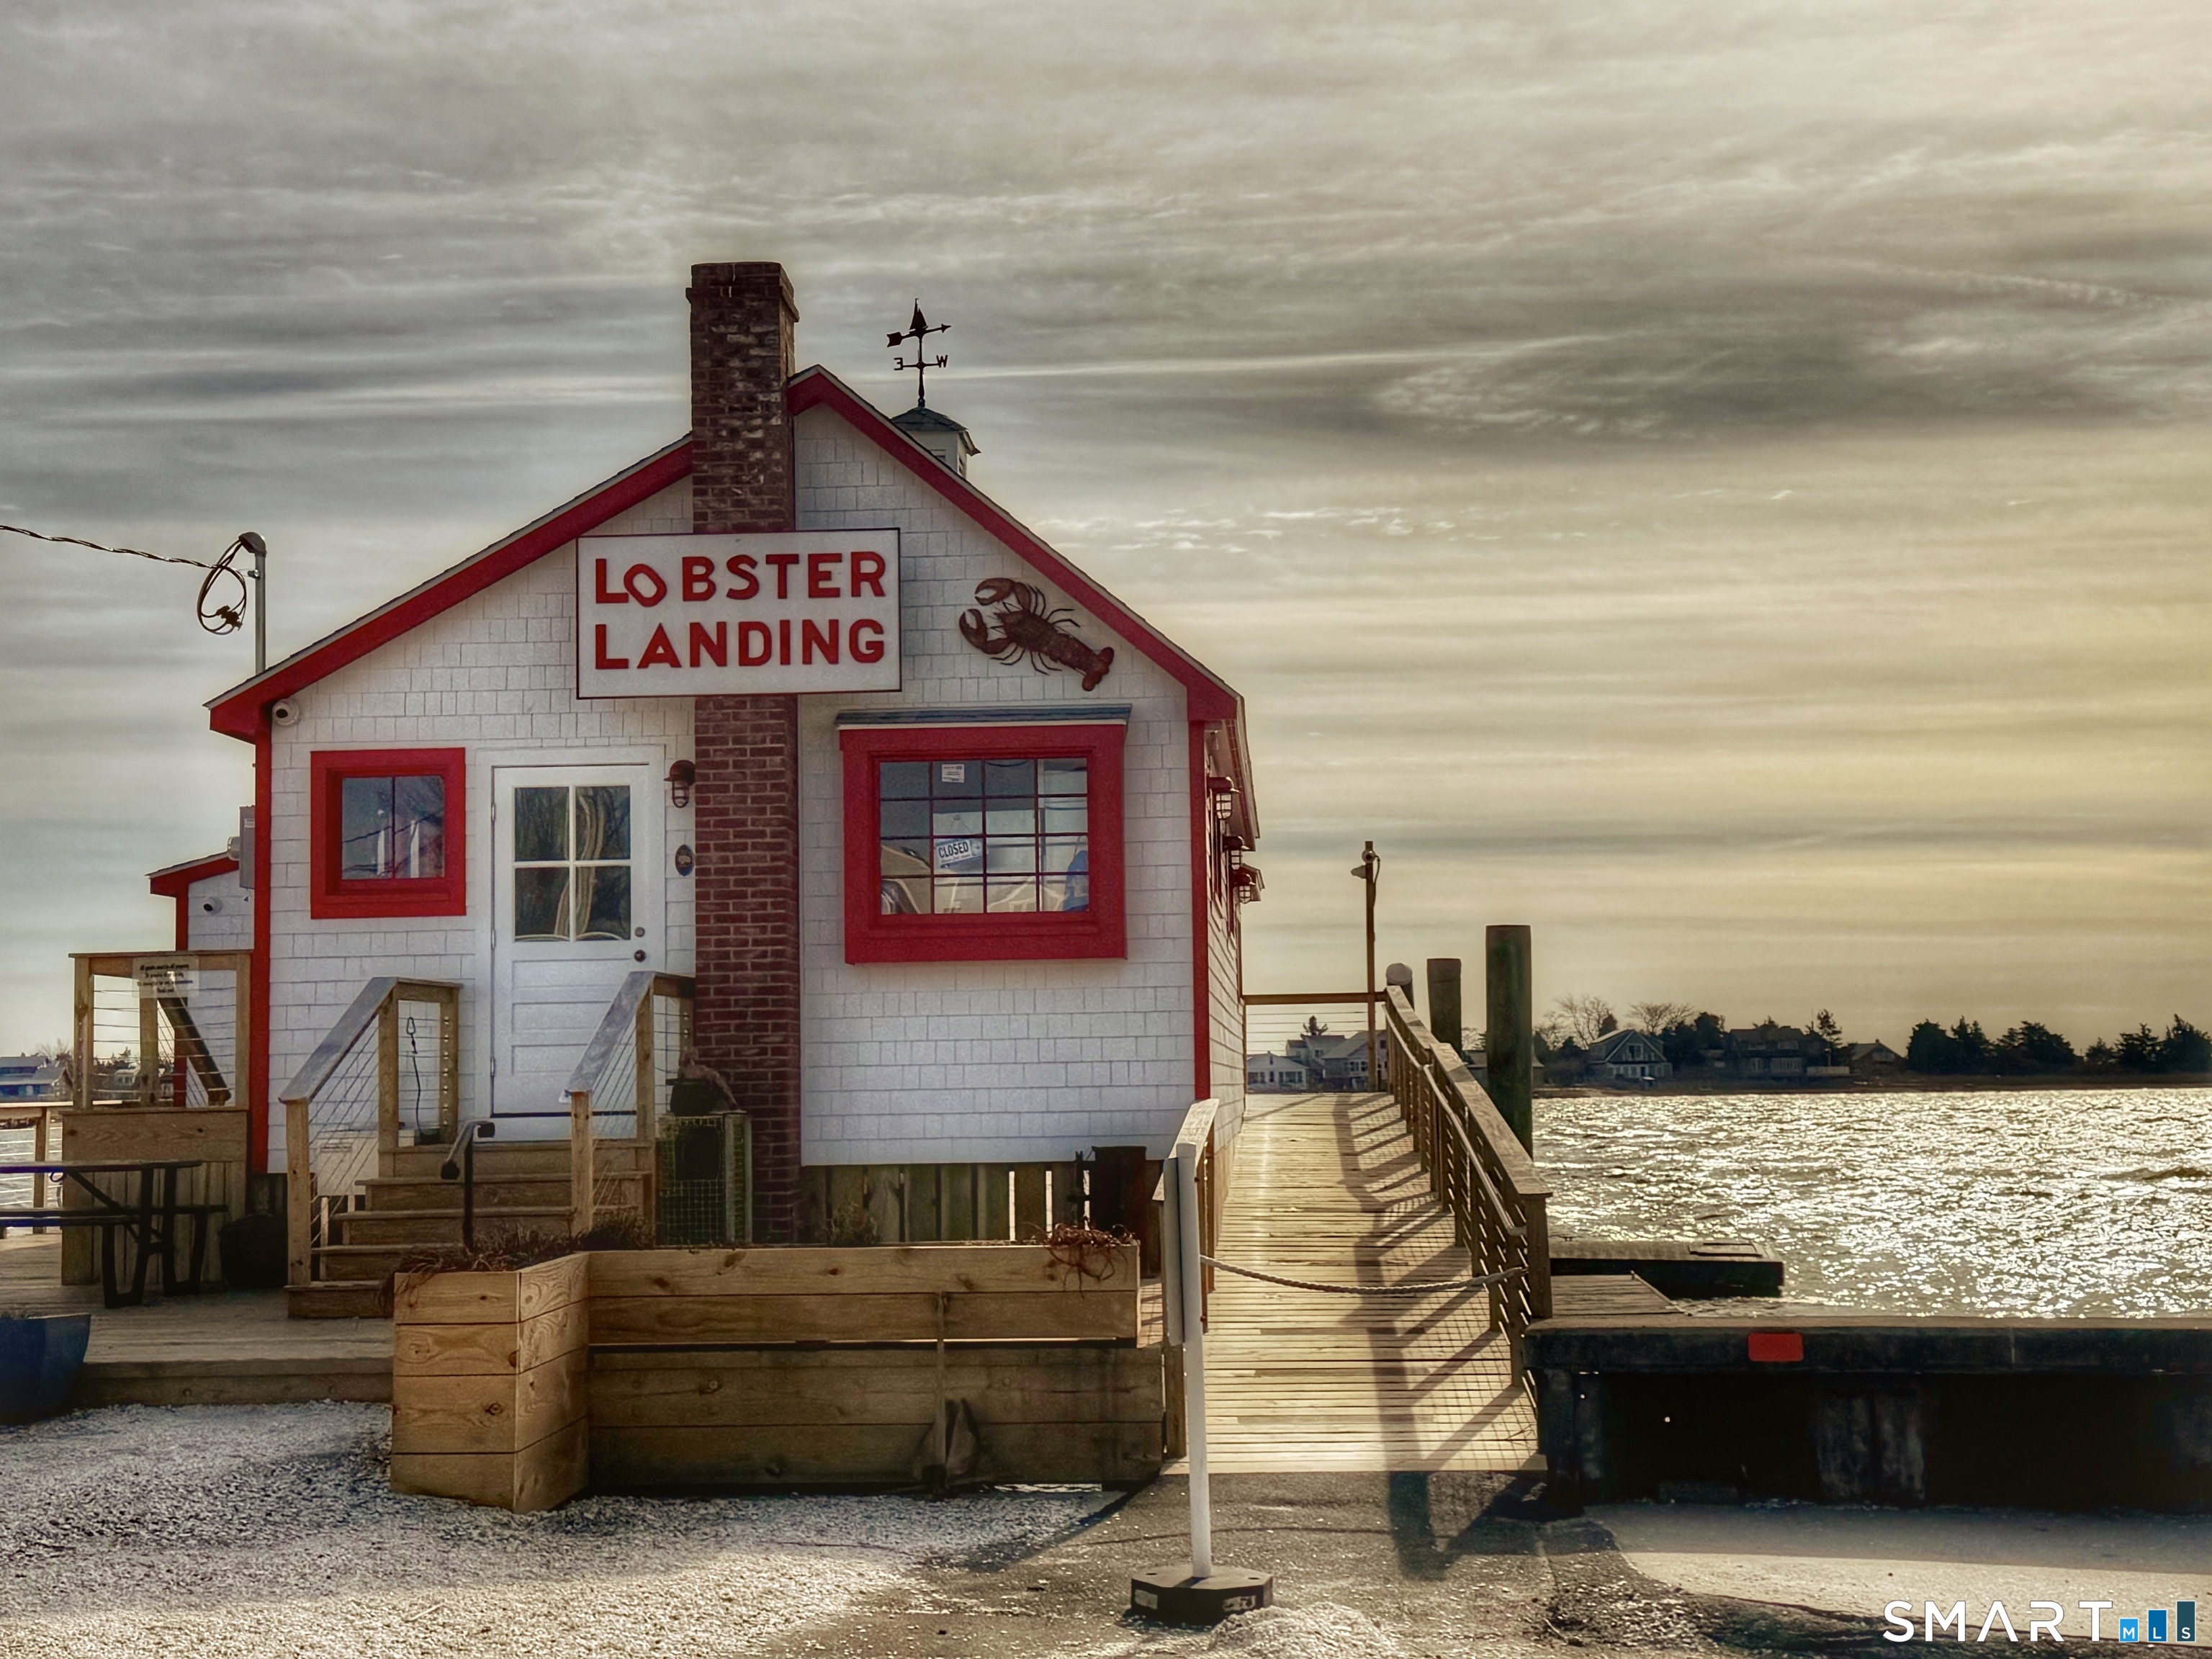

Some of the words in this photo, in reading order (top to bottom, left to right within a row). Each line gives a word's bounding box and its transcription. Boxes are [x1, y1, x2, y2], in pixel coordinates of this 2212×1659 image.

[936, 354, 948, 368] W
[595, 551, 886, 607] LOBSTER
[595, 619, 885, 670] LANDING
[938, 841, 969, 858] CLOSED
